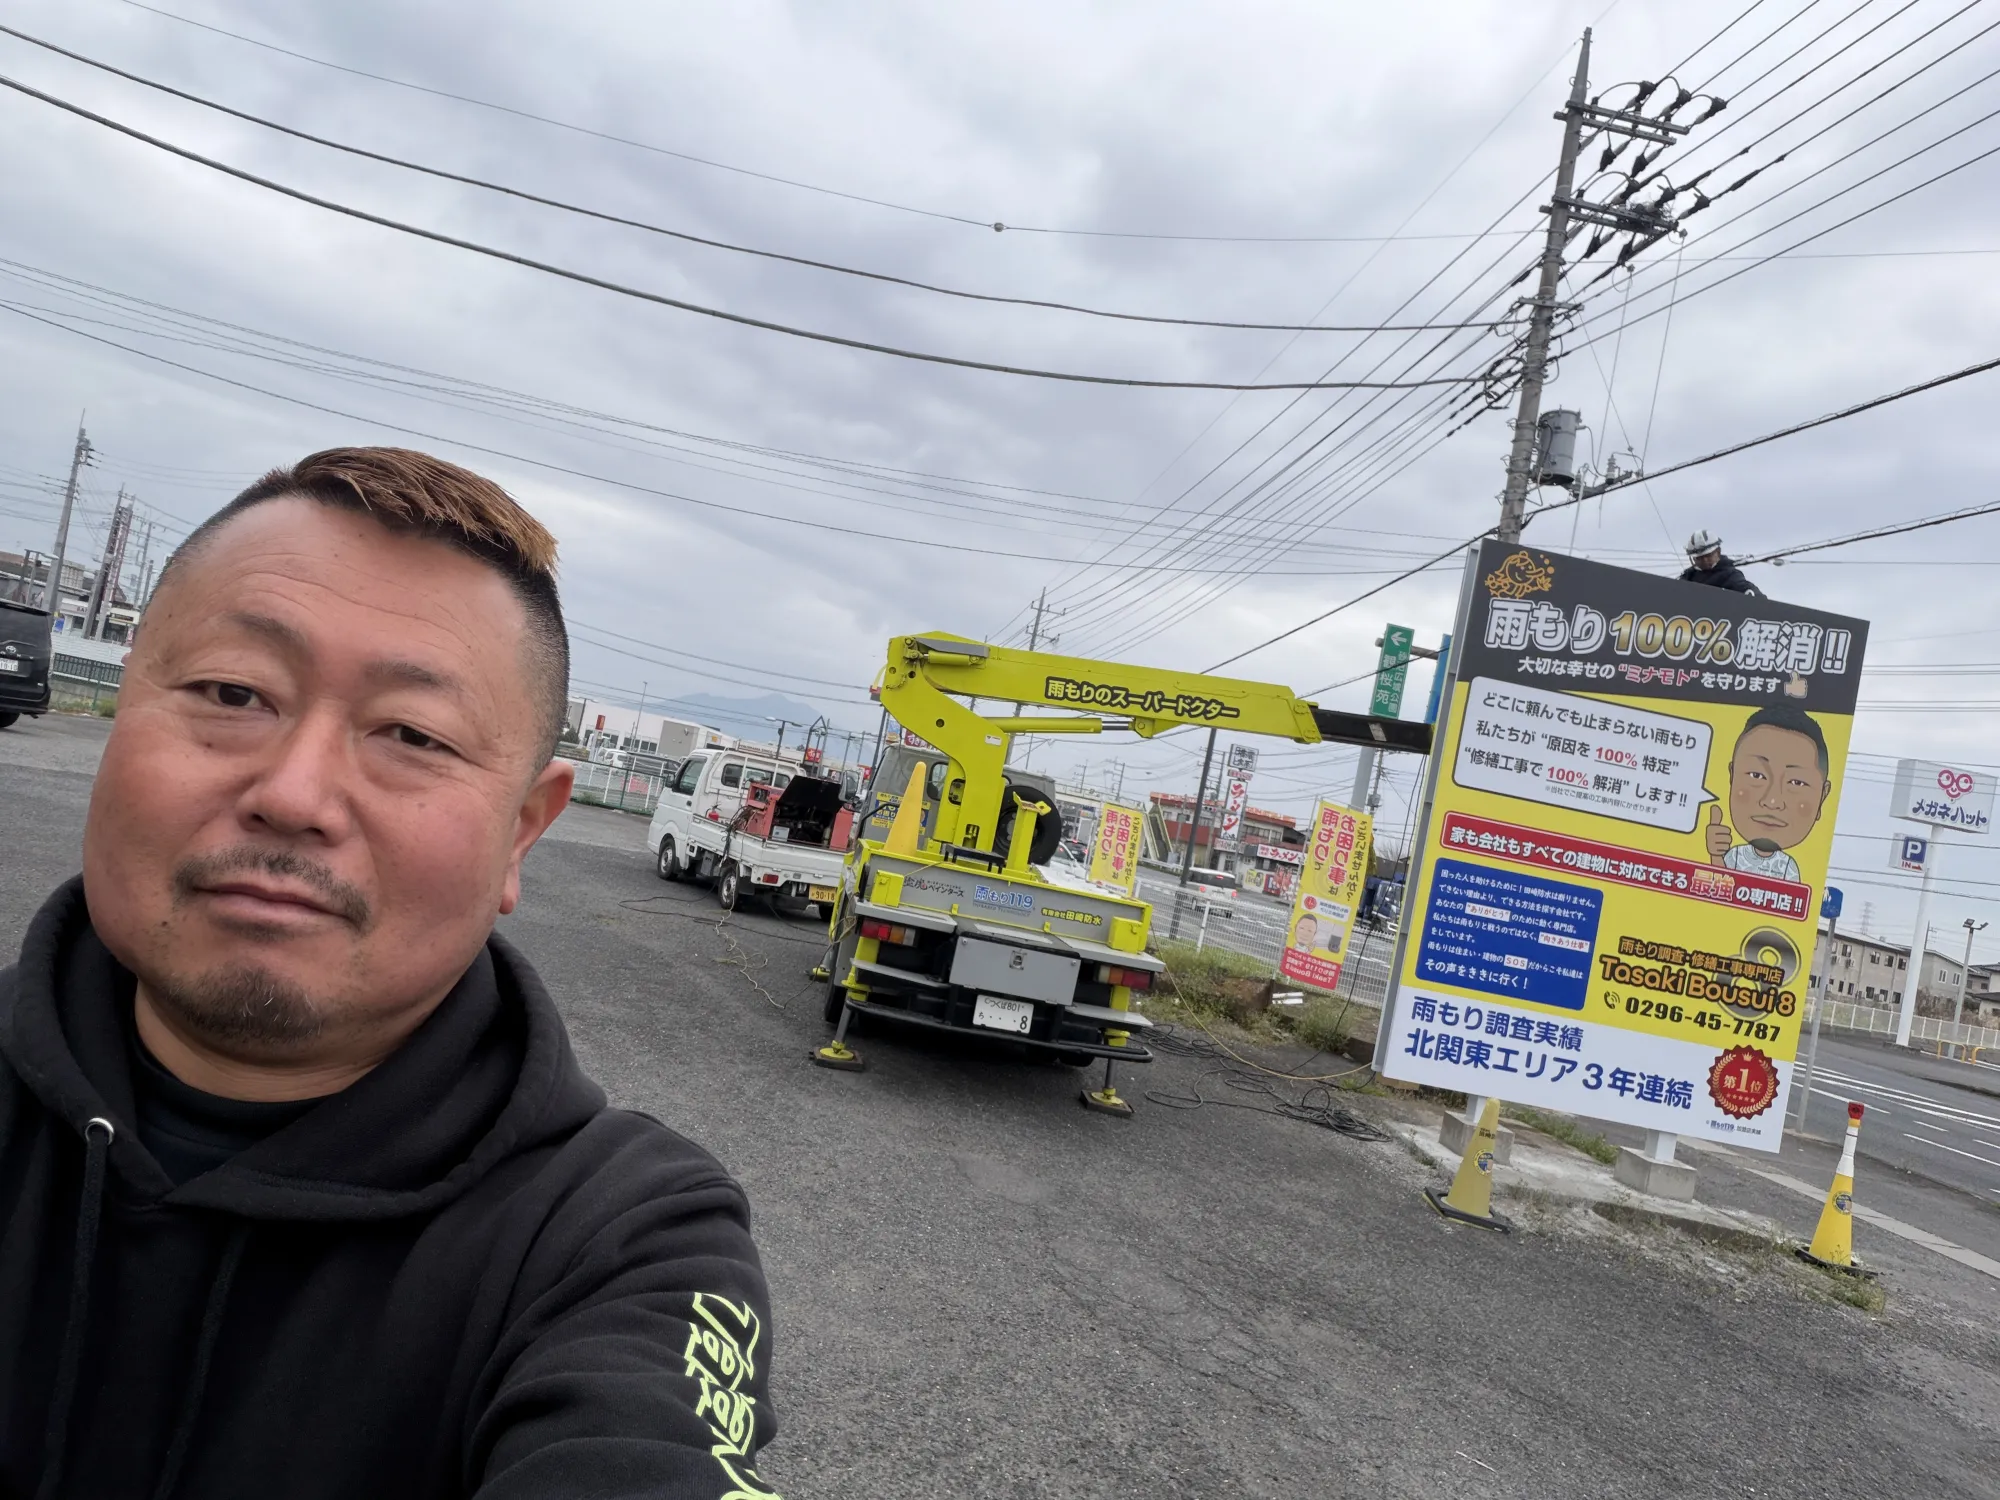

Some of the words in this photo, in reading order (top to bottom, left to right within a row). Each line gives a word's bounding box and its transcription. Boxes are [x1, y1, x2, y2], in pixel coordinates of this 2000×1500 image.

[1045, 676, 1240, 721] 雨もりのスーパードクター
[1482, 691, 1697, 750] どこに頼んでも止まらない雨もり
[1912, 798, 1988, 827] メガネハット
[1901, 861, 1911, 869] IN
[1906, 841, 1922, 859] P
[974, 885, 1034, 908] 雨もり119
[1431, 926, 1475, 943] をしています。
[1600, 955, 1685, 996] Tasaki
[1618, 937, 1783, 984] 雨もり調査・修繕工事専門店
[1410, 996, 1584, 1053] 雨もり調査実績
[1626, 997, 1781, 1042] 0296-45-7787
[1404, 1028, 1694, 1110] 北関東エリア3年連続
[1723, 1068, 1763, 1094] 第1位
